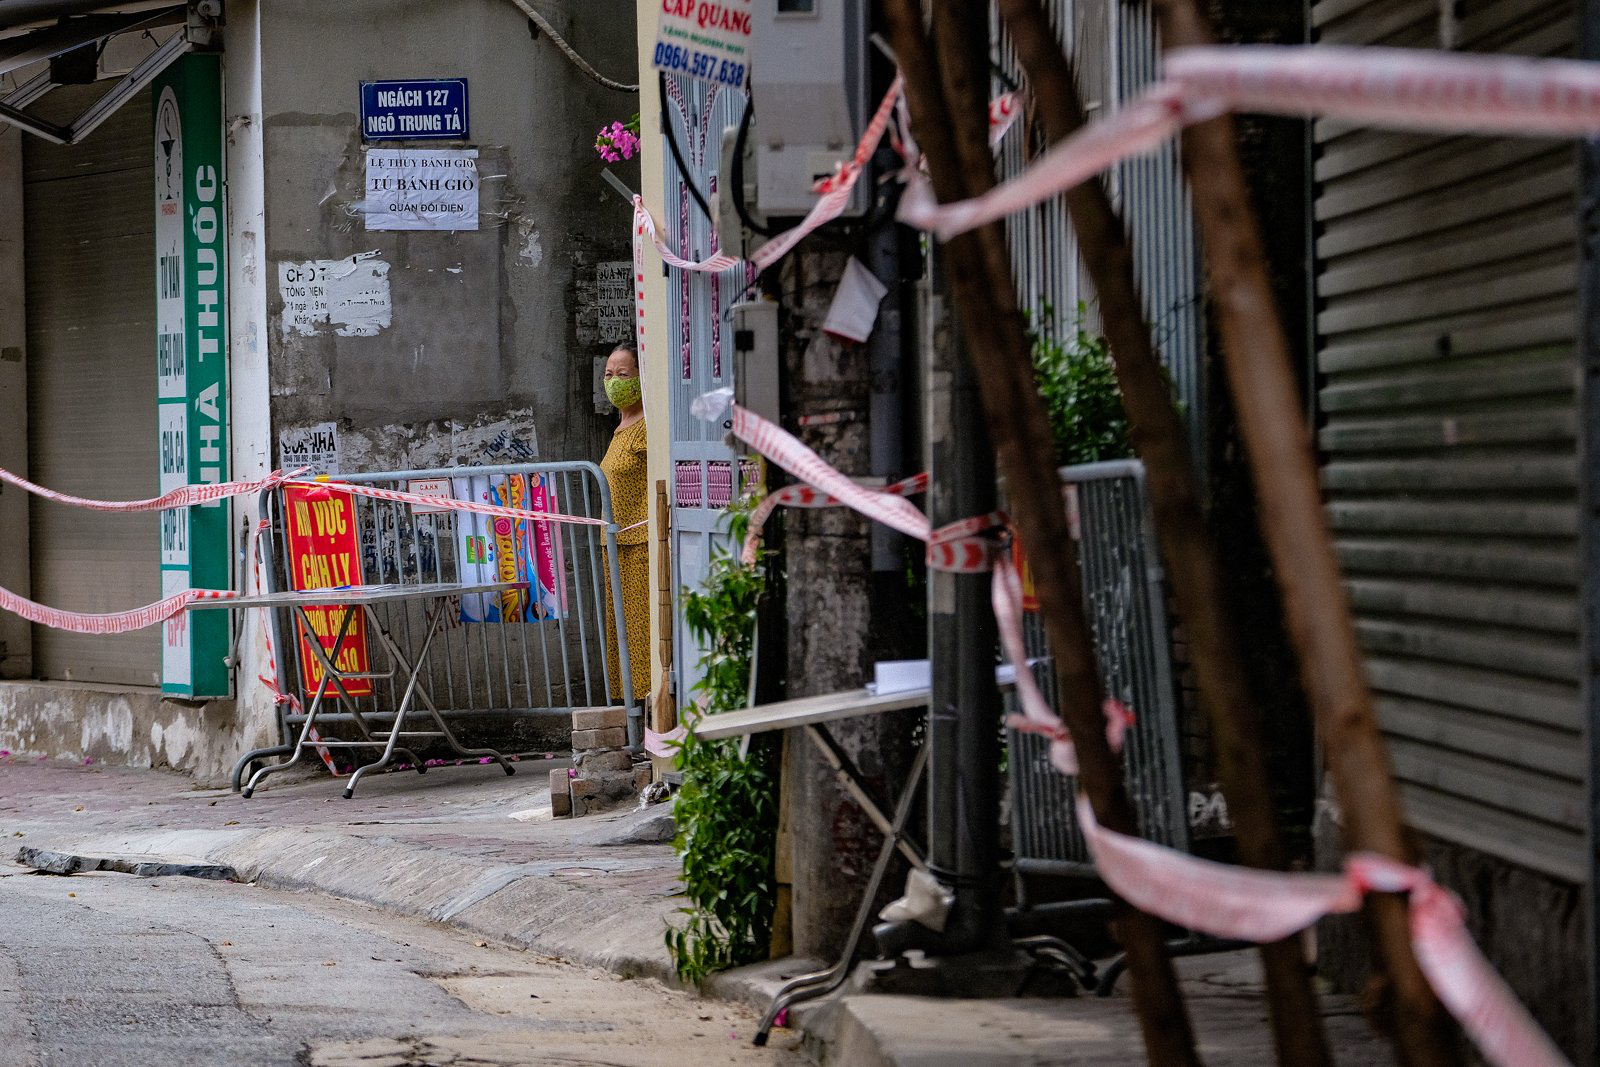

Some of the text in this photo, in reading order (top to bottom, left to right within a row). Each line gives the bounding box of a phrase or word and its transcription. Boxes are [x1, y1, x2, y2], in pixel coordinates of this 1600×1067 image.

[377, 87, 449, 108] NGÁCH 127
[368, 107, 461, 132] NGÕ TRUNG TẢ
[421, 157, 451, 168] BÁNH
[371, 175, 474, 191] TÚ BÁNH GIÒ
[189, 165, 219, 363] THUỐC
